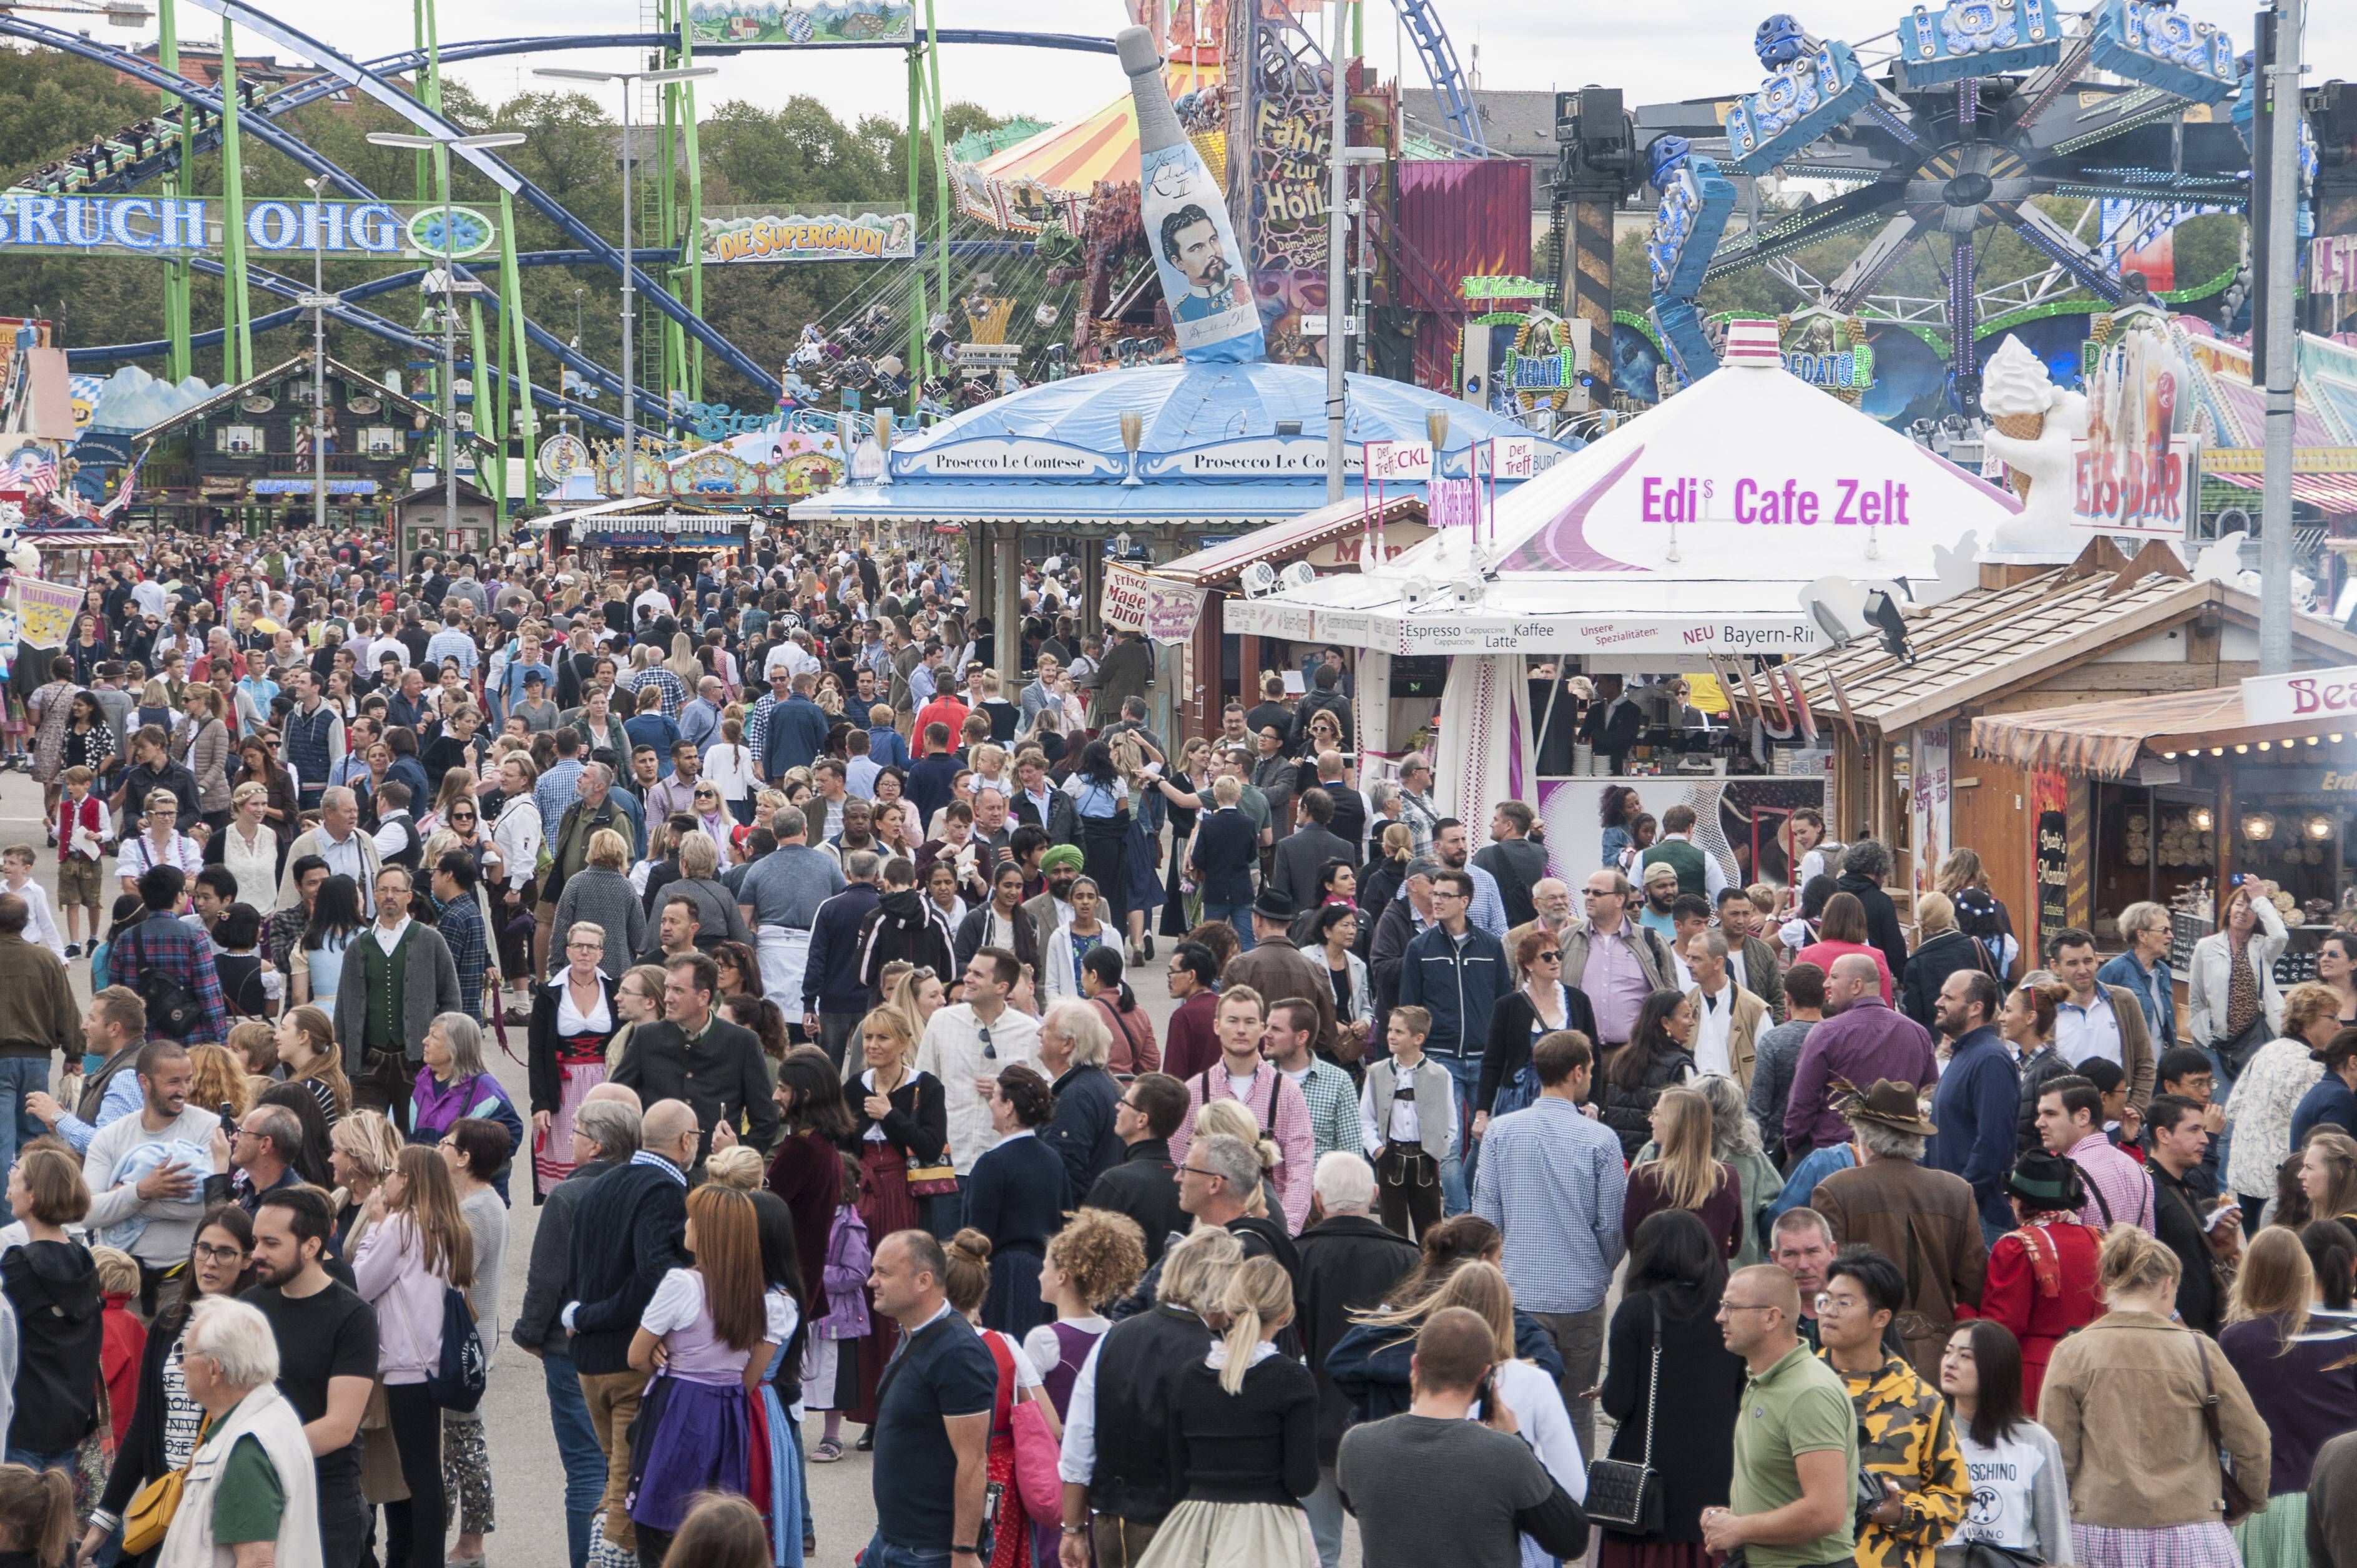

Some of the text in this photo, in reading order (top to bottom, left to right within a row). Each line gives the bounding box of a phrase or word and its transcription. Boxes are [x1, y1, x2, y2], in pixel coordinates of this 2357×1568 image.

[1255, 99, 1333, 154] Fahr
[1283, 159, 1318, 179] zur
[1263, 181, 1327, 220] Höll
[0, 198, 399, 252] RUCH OHG
[718, 222, 884, 263] DIE SUPERGAUDI
[1504, 347, 1574, 389] PREDATOR
[1779, 344, 1873, 386] EDATOR
[1966, 396, 1974, 405] 5
[1377, 447, 1389, 459] Der
[1509, 444, 1527, 458] Der
[936, 454, 1085, 469] Prosecco Le Contesse
[1195, 454, 1270, 469] Prosecco
[1277, 454, 1296, 468] Le
[1376, 457, 1394, 477] Treff
[1506, 454, 1532, 476] Treff
[330, 481, 373, 494] BAHN
[2072, 431, 2182, 524] EIS-BÄR
[1734, 478, 1820, 526] Cafe
[1833, 479, 1910, 526] Zelt
[21, 584, 81, 610] BALLWERFEN
[1106, 584, 1147, 612] Mage
[1107, 604, 1145, 627] -brot
[1406, 624, 1461, 639] Espresso
[1465, 626, 1506, 634] Cappuccino
[1514, 623, 1554, 636] Kaffee
[1580, 624, 1614, 637] Unsere
[1595, 627, 1659, 646] Spezialitäten:
[1683, 625, 1715, 645] NEU
[1434, 635, 1517, 647] Cappuccino Latte
[1965, 1463, 2017, 1482] OSCHINO
